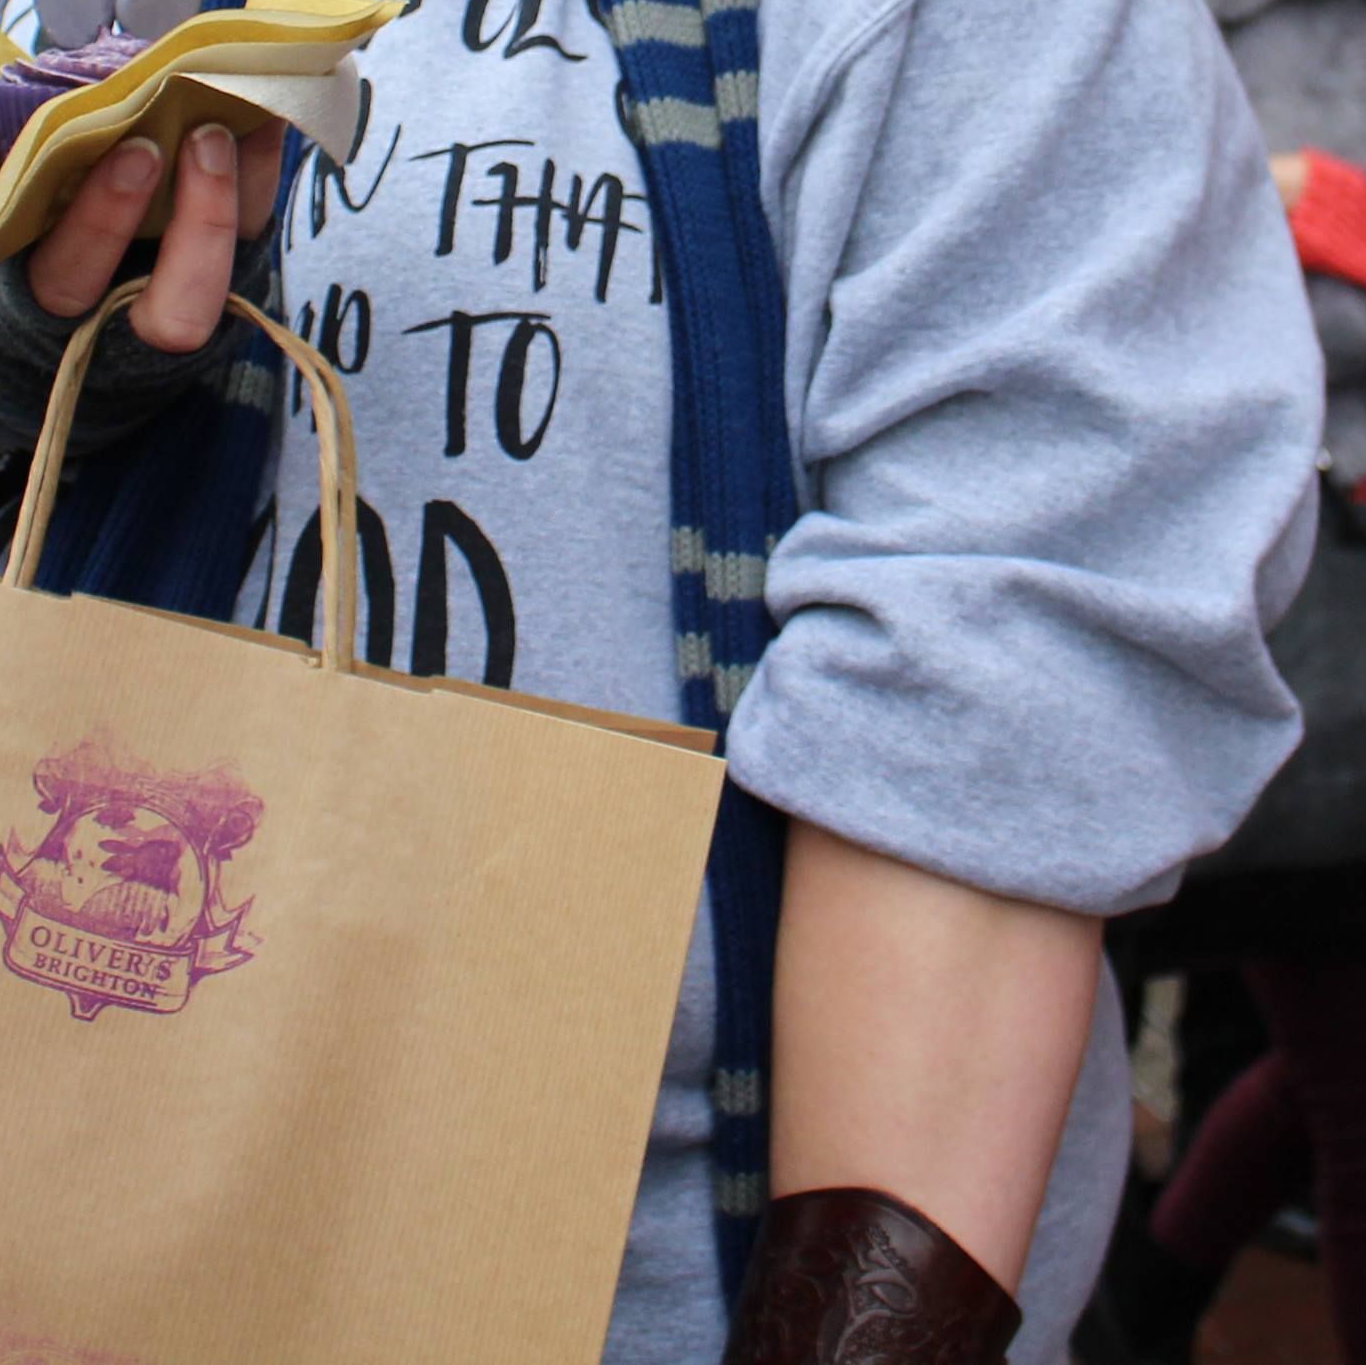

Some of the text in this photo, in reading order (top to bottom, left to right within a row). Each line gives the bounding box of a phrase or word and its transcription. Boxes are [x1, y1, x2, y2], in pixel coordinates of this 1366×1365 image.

[402, 310, 561, 462] TO
[29, 925, 172, 982] OLIVER'S
[33, 952, 158, 1000] BRIGHTON
